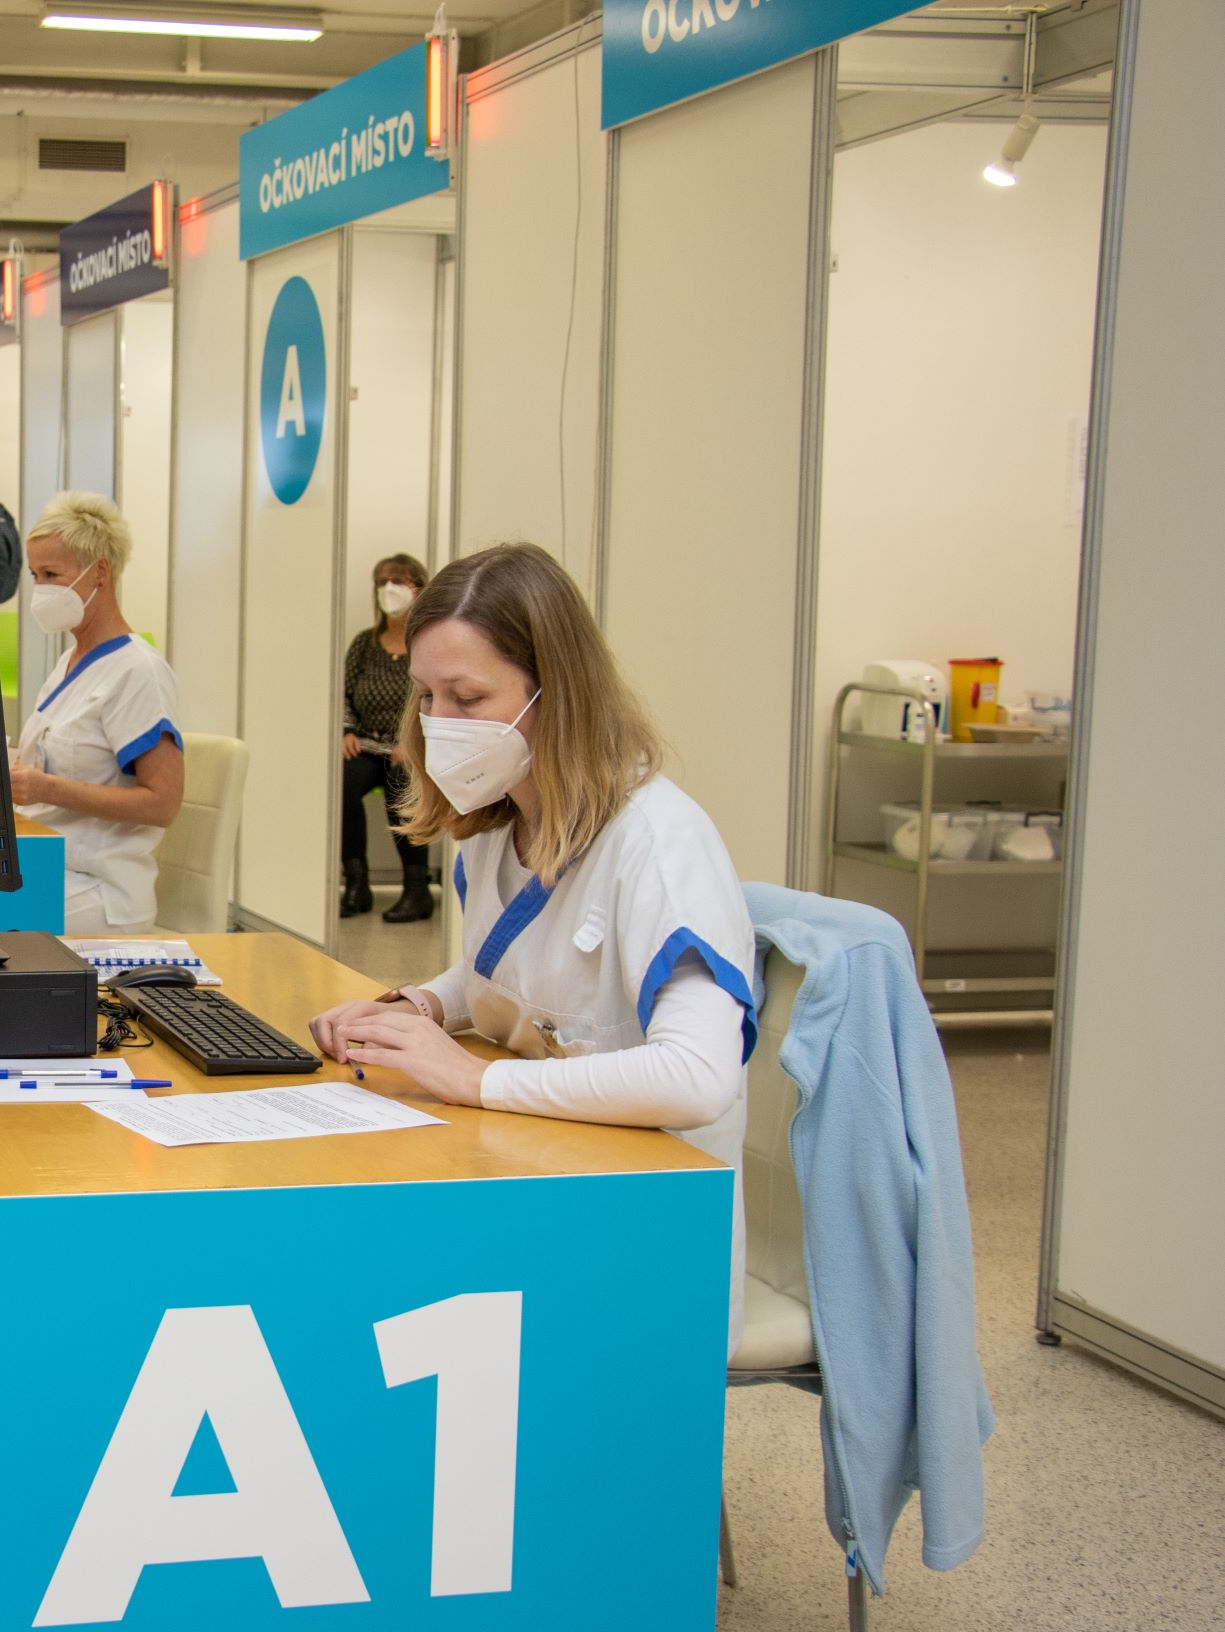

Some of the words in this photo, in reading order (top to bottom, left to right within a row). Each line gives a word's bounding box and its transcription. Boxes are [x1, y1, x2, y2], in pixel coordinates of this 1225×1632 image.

[259, 127, 348, 213] OČKOVACÍ
[351, 111, 414, 177] MÍSTO
[70, 236, 117, 293] OČKOVACÍ
[118, 229, 151, 274] MÍSTO
[276, 344, 306, 438] A
[31, 1288, 523, 1627] A1
